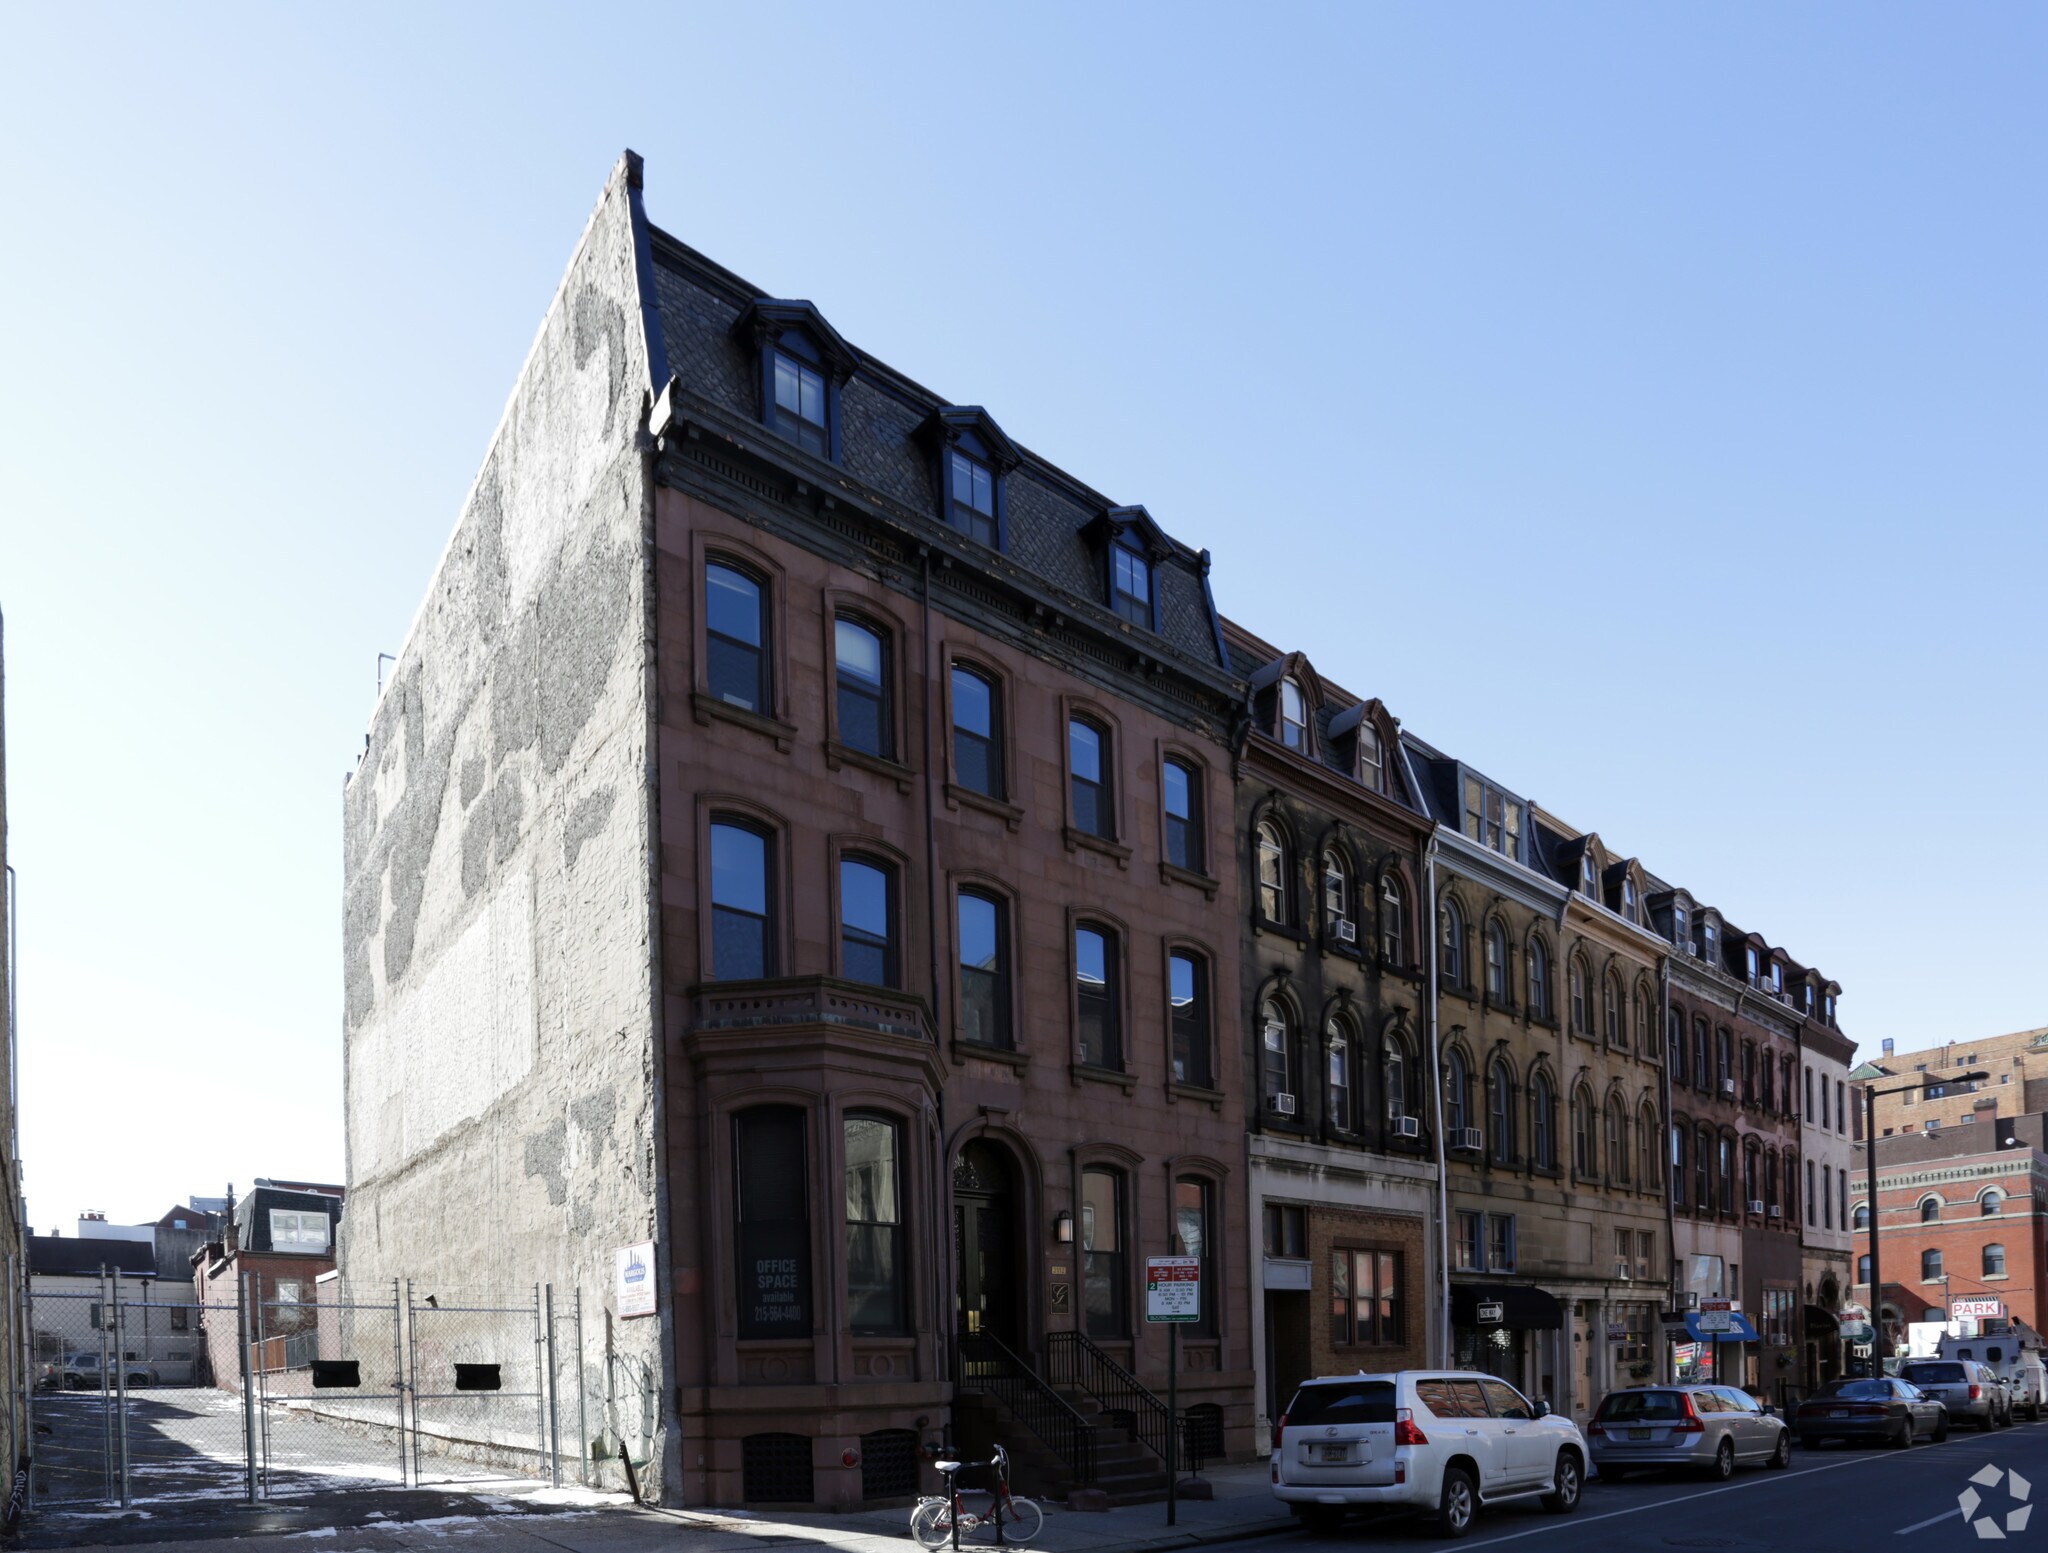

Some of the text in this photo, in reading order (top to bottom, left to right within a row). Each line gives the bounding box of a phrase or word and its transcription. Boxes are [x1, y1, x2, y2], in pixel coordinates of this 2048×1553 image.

[757, 1259, 797, 1273] OFFICE
[758, 1274, 798, 1288] SPACE
[1149, 1282, 1156, 1290] 2
[762, 1291, 794, 1302] available
[755, 1305, 801, 1321] 215-564-4400
[1953, 1302, 1996, 1314] PARK
